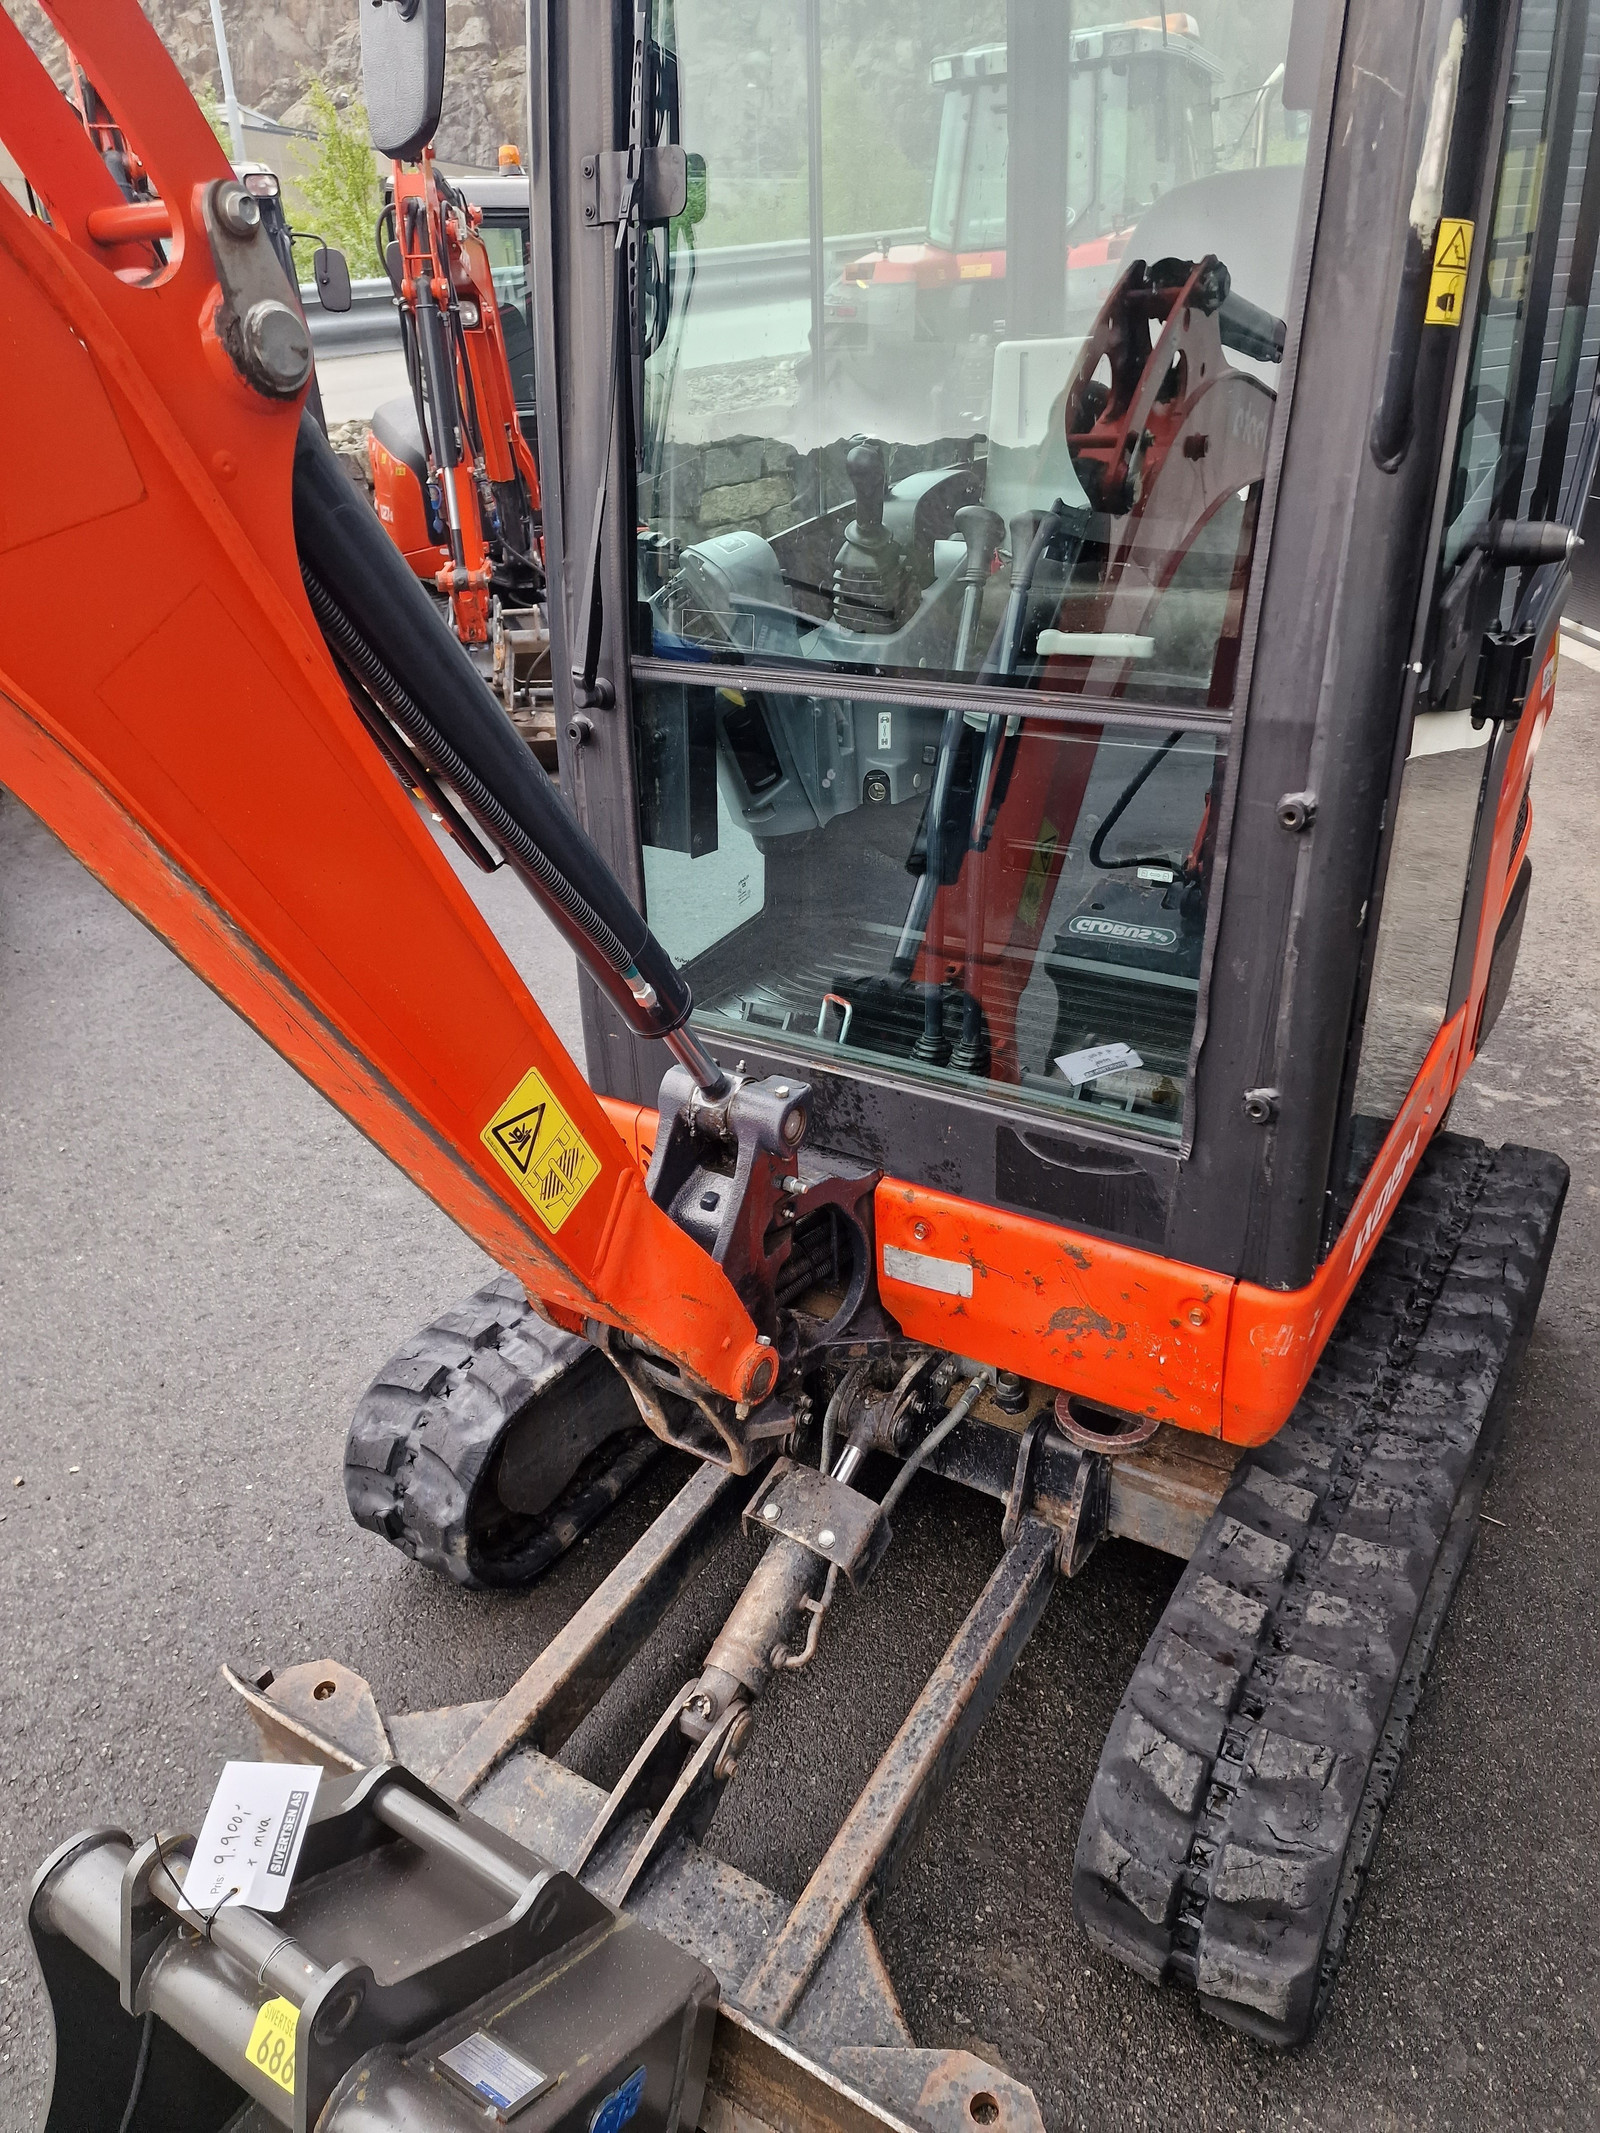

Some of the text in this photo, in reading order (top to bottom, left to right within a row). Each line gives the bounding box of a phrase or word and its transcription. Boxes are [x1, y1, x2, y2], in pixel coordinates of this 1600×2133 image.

[254, 1817, 271, 1848] mva
[270, 1792, 303, 1873] SIVERTSEN AS
[210, 1873, 225, 1895] Pris:
[264, 2002, 295, 2039] SIVERTSE
[257, 2029, 295, 2085] 686
